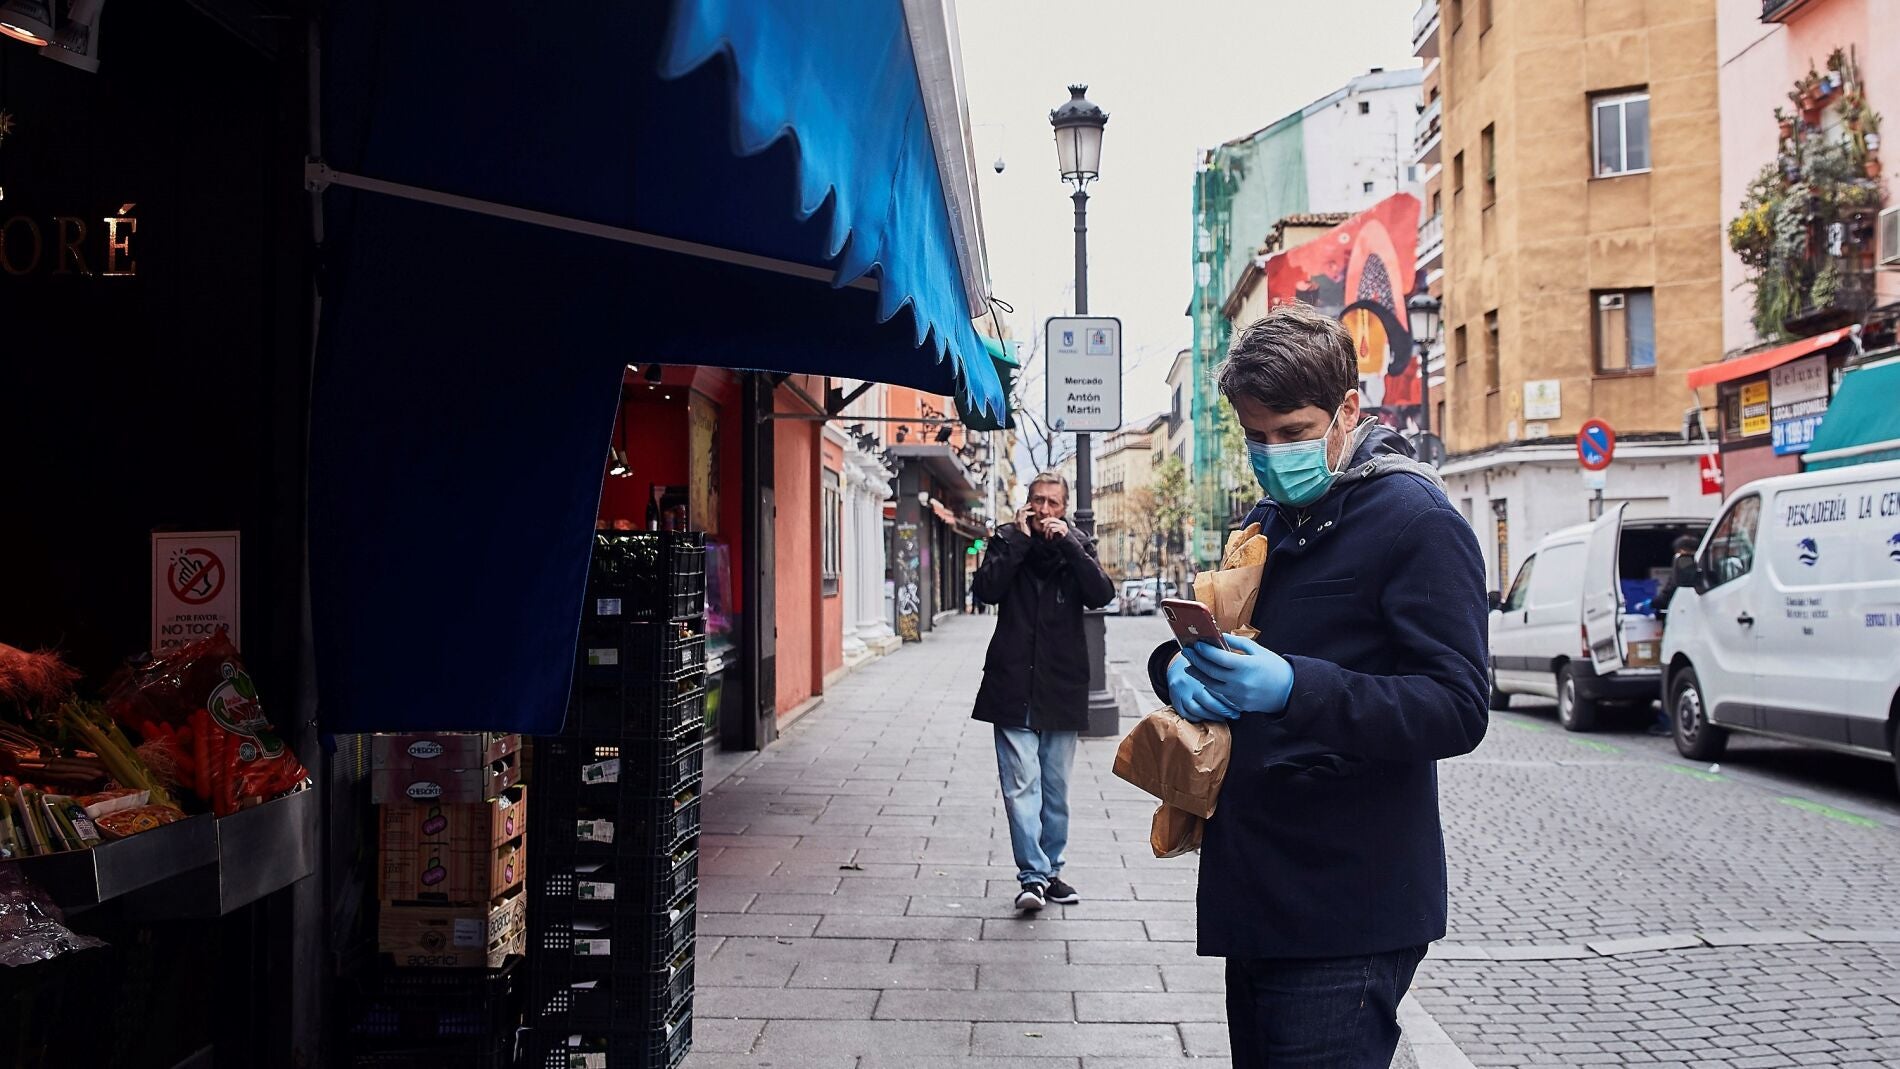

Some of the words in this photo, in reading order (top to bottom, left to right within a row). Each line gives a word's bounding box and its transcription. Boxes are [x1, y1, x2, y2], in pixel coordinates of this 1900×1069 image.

[1065, 377, 1103, 385] Mercado
[1067, 392, 1101, 402] Antón
[1786, 493, 1847, 526] PESCADERÍA
[1858, 495, 1872, 519] LA
[161, 624, 183, 635] NO
